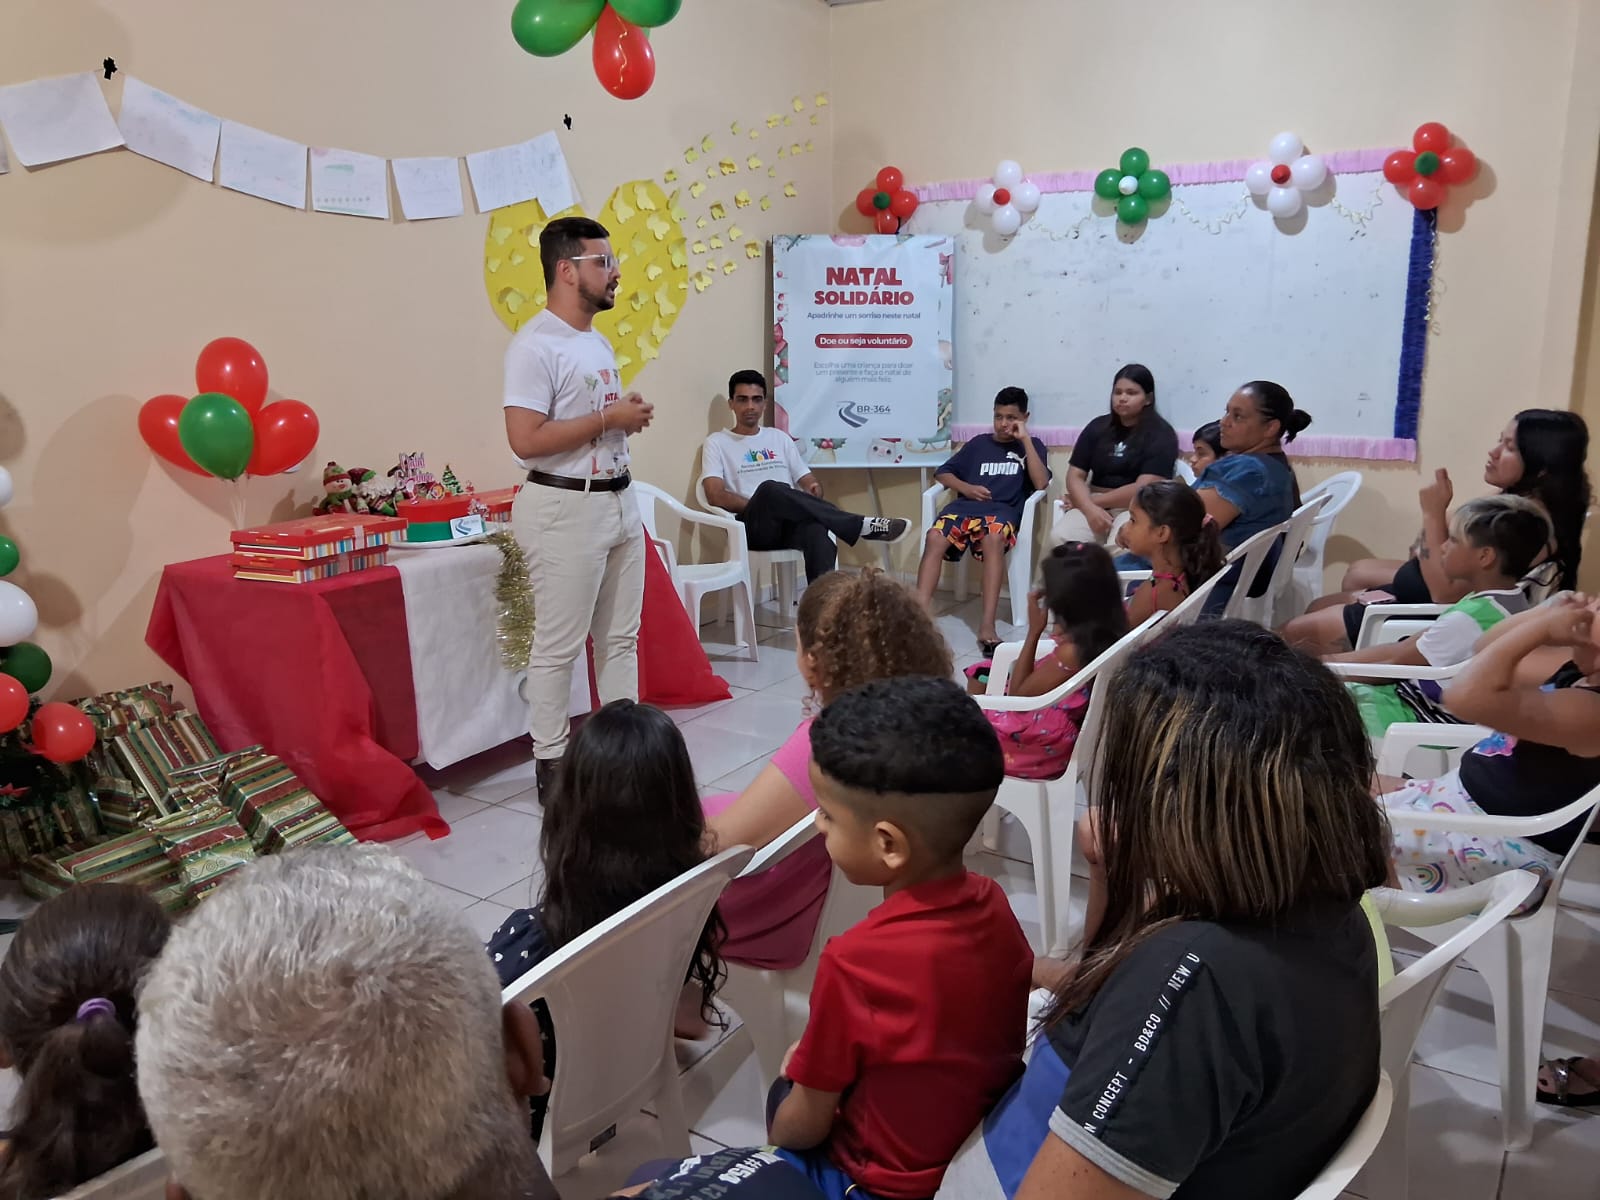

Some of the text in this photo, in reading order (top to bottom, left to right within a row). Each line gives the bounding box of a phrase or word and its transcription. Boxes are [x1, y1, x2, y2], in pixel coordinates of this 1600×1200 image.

[826, 267, 902, 286] NATAL
[814, 286, 914, 305] SOLIDÁRIO
[820, 337, 837, 345] Doe
[850, 337, 866, 346] seja
[867, 337, 908, 345] voluntário
[857, 405, 891, 413] BR-364
[979, 461, 1020, 476] PUMA
[1092, 1071, 1128, 1120] CONCEPT
[1134, 1013, 1161, 1052] BD&CO
[1167, 964, 1192, 991] NEW
